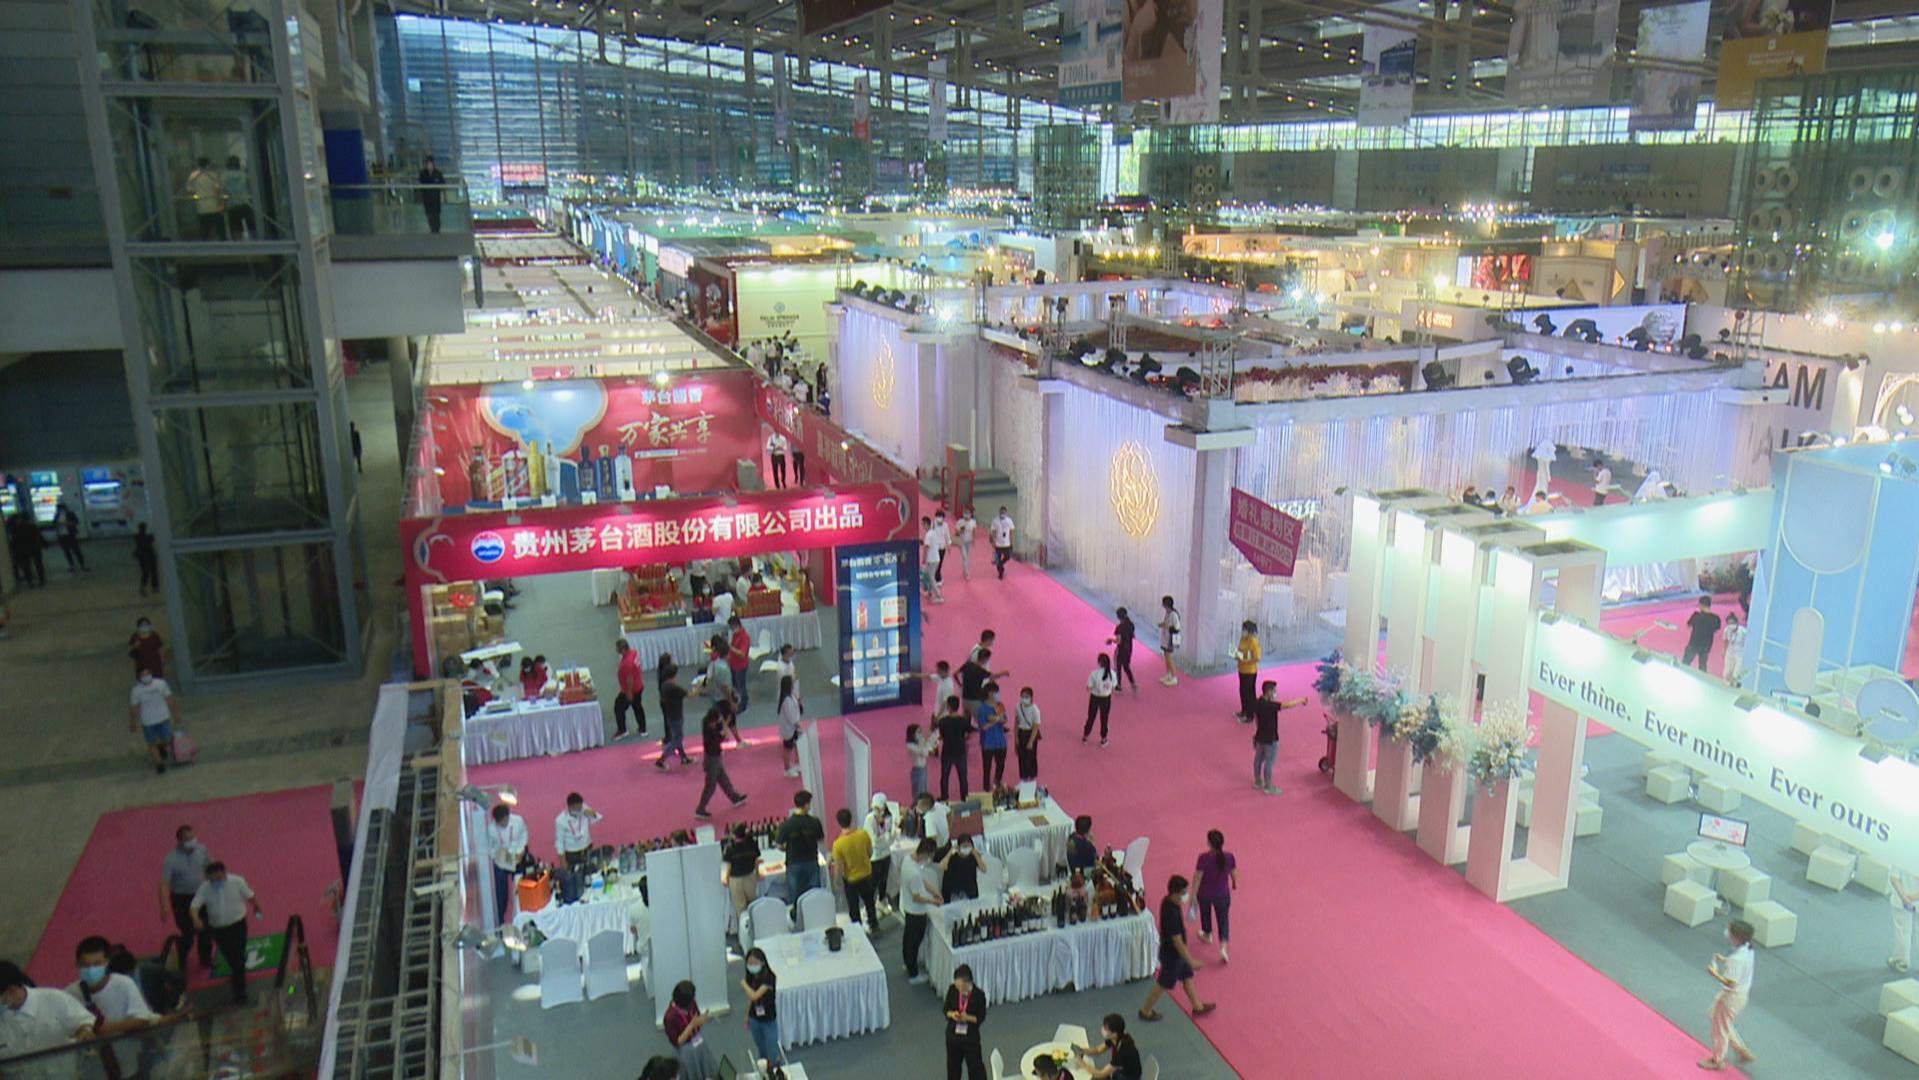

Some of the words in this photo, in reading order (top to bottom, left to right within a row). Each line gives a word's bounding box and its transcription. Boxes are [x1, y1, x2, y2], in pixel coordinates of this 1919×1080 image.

[512, 503, 864, 558] 贵州茅台酒股份有限公司出品
[1538, 660, 1576, 695] Ever
[1580, 680, 1632, 721] thine.
[1644, 709, 1688, 747] Ever
[1692, 732, 1755, 779] mine.
[1770, 766, 1823, 809] Ever
[1831, 801, 1891, 841] ours
